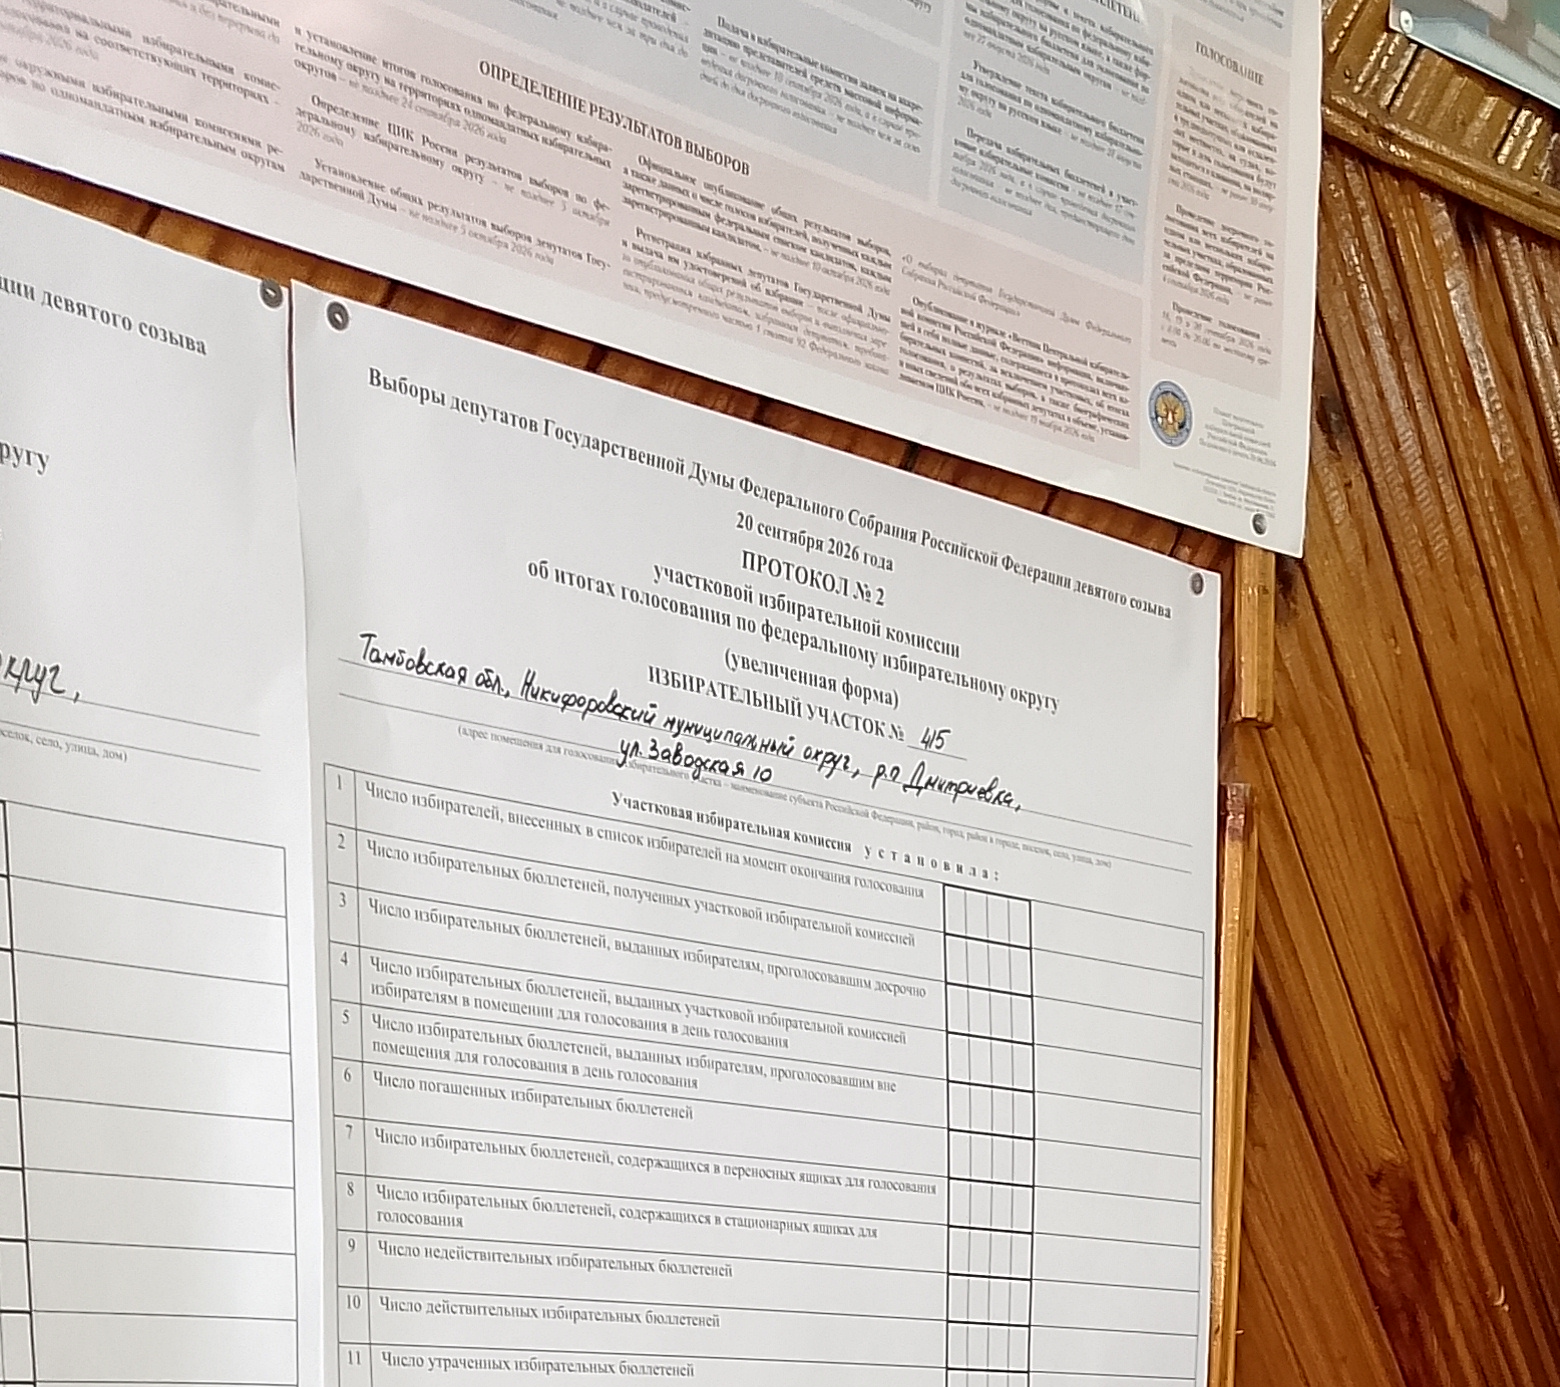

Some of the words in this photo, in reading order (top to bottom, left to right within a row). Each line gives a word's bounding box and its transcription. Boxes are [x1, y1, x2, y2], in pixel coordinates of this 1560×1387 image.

[480, 60, 586, 114] ОПРЕДЕЛЕНИЕ
[590, 102, 682, 150] РЕЗУЛЬТАТОВ
[685, 139, 749, 176] ВЫБОРОВ
[41, 290, 132, 331] девятого
[139, 322, 206, 356] созыва
[0, 442, 49, 476] ругу
[370, 367, 445, 406] Выборы
[450, 396, 538, 432] депутатов
[544, 418, 684, 476] Государственной
[688, 461, 734, 490] Думы
[740, 476, 844, 521] Федерального
[849, 509, 917, 543] Собрания
[921, 529, 997, 567] Российской
[1002, 554, 1071, 590] Федерации
[1074, 580, 1126, 605] девятого
[1130, 597, 1170, 619] созыва
[737, 511, 753, 531] 20
[758, 522, 823, 553] сентября
[828, 537, 859, 561] 2026
[864, 552, 893, 571] года
[743, 550, 848, 597] ПРОТОКОЛ
[853, 581, 871, 603] №
[876, 588, 884, 606] 2
[528, 560, 548, 580] об
[555, 568, 615, 598] итогах
[622, 586, 730, 627] голосования
[737, 616, 756, 633] по
[762, 618, 878, 669] федеральному
[883, 654, 1006, 702] избирательному
[1011, 688, 1059, 715] округу
[654, 564, 752, 604] участковой
[759, 592, 880, 637] избирательной
[886, 627, 959, 658] комиссии
[649, 665, 801, 718] ИЗБИРАТЕЛЬНЫЙ
[807, 703, 885, 738] УЧАСТОК
[889, 723, 904, 742] №
[725, 648, 836, 693] (увеличенная
[842, 677, 898, 710] форма)
[65, 742, 100, 757] улица,
[102, 748, 128, 762] дом)
[612, 791, 692, 821] Участковая
[697, 811, 790, 841] избирательная
[794, 831, 851, 853] комиссия
[344, 1067, 351, 1082] 6
[373, 1070, 415, 1090] Число
[419, 1080, 506, 1100] погашенных
[511, 1087, 612, 1112] избирательных
[616, 1097, 693, 1120] бюллетеней
[347, 1294, 360, 1310] 10
[380, 1296, 422, 1312] Число
[426, 1299, 538, 1319] действительных
[542, 1305, 641, 1324] избирательных
[645, 1309, 719, 1328] бюллетеней
